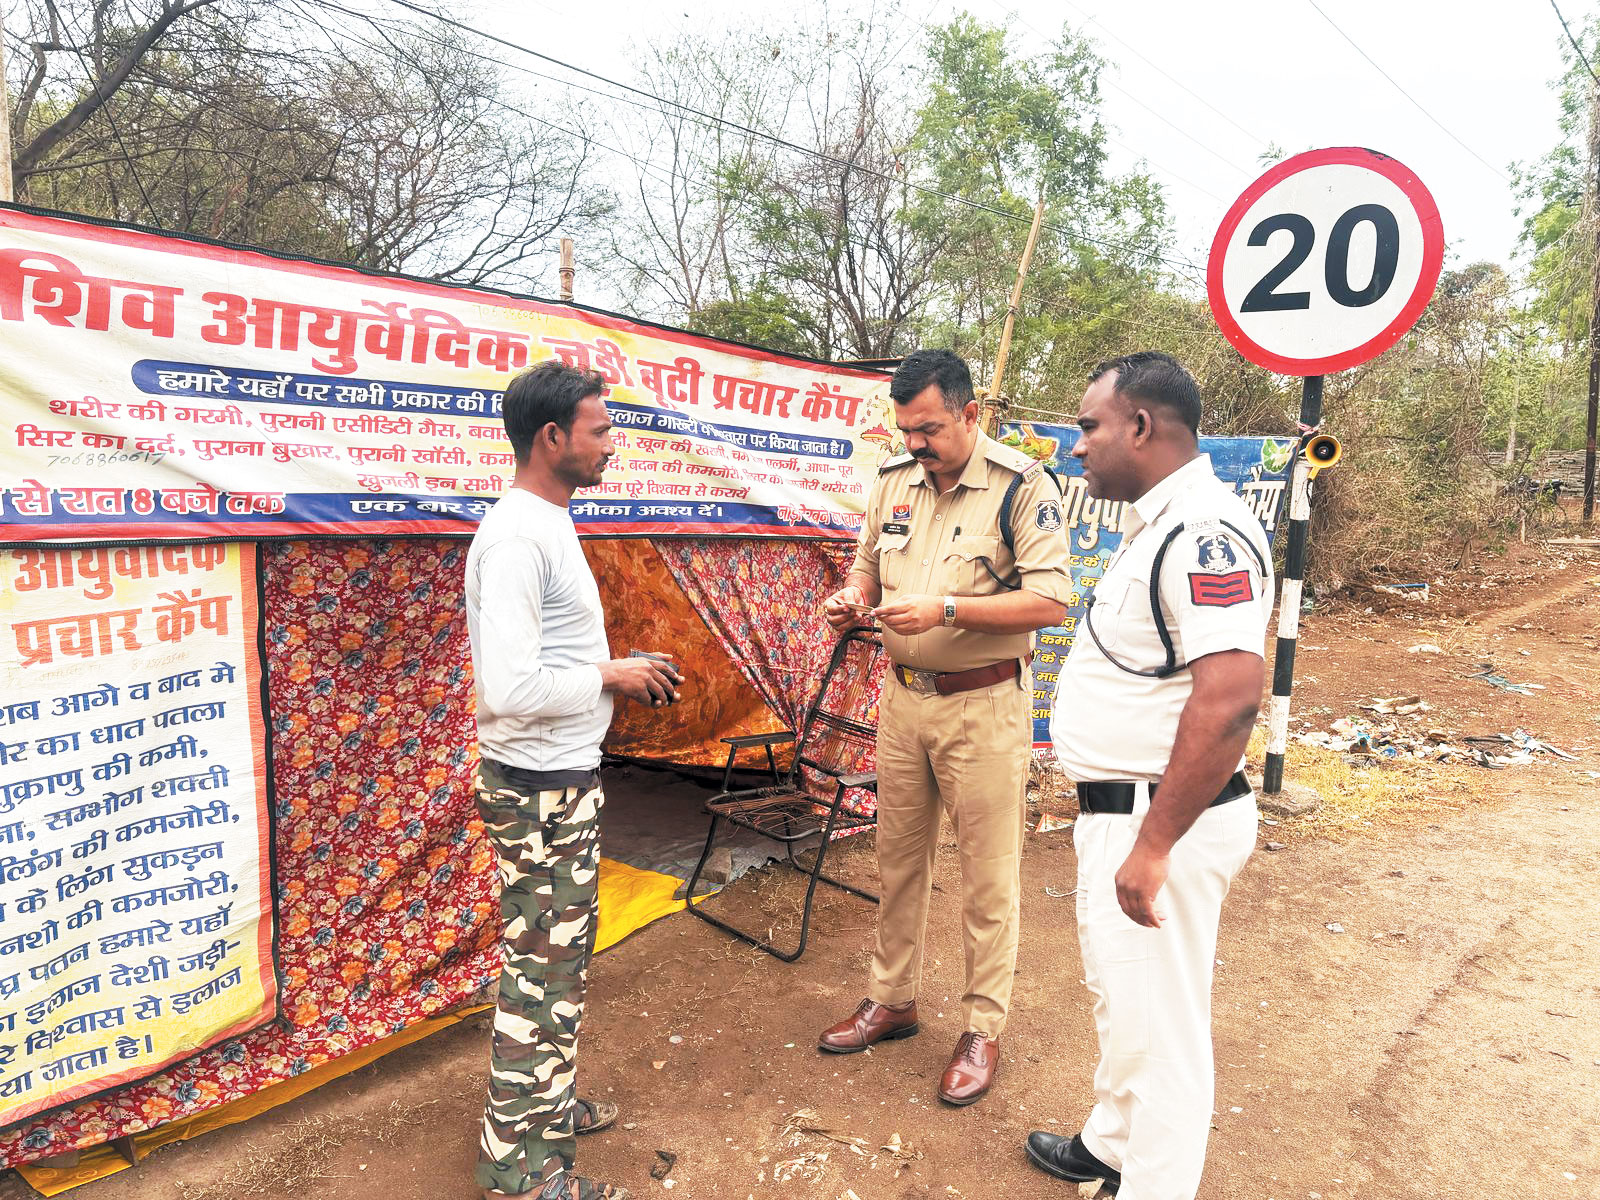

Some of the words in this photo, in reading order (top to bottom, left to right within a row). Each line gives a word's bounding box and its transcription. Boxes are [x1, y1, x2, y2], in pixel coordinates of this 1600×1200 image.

[1240, 203, 1400, 313] 20
[0, 248, 184, 338] शिव
[200, 291, 530, 375] आयुर्वेदिक
[637, 357, 705, 410] बूटी
[712, 373, 800, 419] प्रचार
[801, 382, 865, 427] कैंप
[48, 396, 121, 419] शरीर
[127, 400, 167, 422] की
[174, 405, 252, 427] गरमी,
[259, 411, 326, 433] पुरानी
[332, 415, 412, 435] एसीडिटी
[418, 418, 461, 439] गैस,
[636, 436, 668, 454] खून
[670, 438, 692, 453] की
[838, 465, 854, 478] पूरा
[156, 369, 231, 394] हमारे
[296, 382, 331, 402] पर
[335, 383, 386, 406] सभी
[391, 388, 454, 410] प्रकार
[456, 390, 486, 413] की
[750, 433, 768, 447] पर
[769, 433, 799, 451] किया
[801, 440, 828, 455] जाता
[830, 440, 845, 456] है।
[15, 424, 75, 447] सिर
[82, 432, 128, 450] का
[135, 434, 185, 457] दर्द,
[193, 439, 265, 461] पुराना
[272, 442, 341, 463] बुखार,
[347, 445, 405, 466] पुरानी
[479, 453, 517, 466] कम
[629, 459, 659, 472] बदन
[662, 459, 683, 474] की
[821, 480, 847, 494] शरीर
[849, 482, 863, 494] की
[356, 472, 419, 492] खुजली
[425, 476, 457, 492] इन
[463, 475, 503, 492] सभी
[626, 480, 644, 498] पूरे
[648, 480, 691, 496] विश्वास
[694, 483, 708, 496] से
[710, 486, 751, 500] करायें
[12, 478, 52, 515] से
[60, 487, 125, 515] रात
[132, 487, 154, 515] 8
[161, 481, 220, 515] बजे
[225, 490, 286, 516] तक
[349, 500, 409, 514] एक
[416, 500, 465, 514] बार
[572, 501, 632, 516] मौका
[637, 505, 694, 517] अवश्य
[698, 504, 723, 517] दें।
[11, 608, 143, 669] प्रचार
[152, 588, 233, 643] कैंप
[51, 683, 120, 716] आगे
[128, 682, 151, 702] व
[158, 669, 202, 694] बाद
[35, 731, 81, 756] का
[90, 718, 146, 744] धात
[152, 701, 226, 728] पतला
[91, 752, 133, 781] की
[139, 734, 209, 768] कमी,
[44, 786, 144, 831] सम्भोग
[151, 765, 230, 798] शक्ती
[71, 829, 109, 859] की
[115, 800, 240, 843] कमजोरी,
[15, 888, 48, 914] के
[56, 864, 115, 902] लिंग
[122, 841, 225, 881] सुकड़न
[66, 899, 104, 930] की
[111, 870, 239, 914] कमजोरी,
[25, 974, 101, 1025] इलाज
[109, 955, 170, 987] देशी
[177, 939, 241, 971] जड़ी-
[28, 941, 90, 981] पतन
[98, 919, 173, 955] हमारे
[24, 1006, 125, 1056] विश्वास
[133, 995, 162, 1023] से
[170, 966, 242, 1014] इलाज
[40, 1046, 108, 1081] जाता
[115, 1034, 153, 1060] है।
